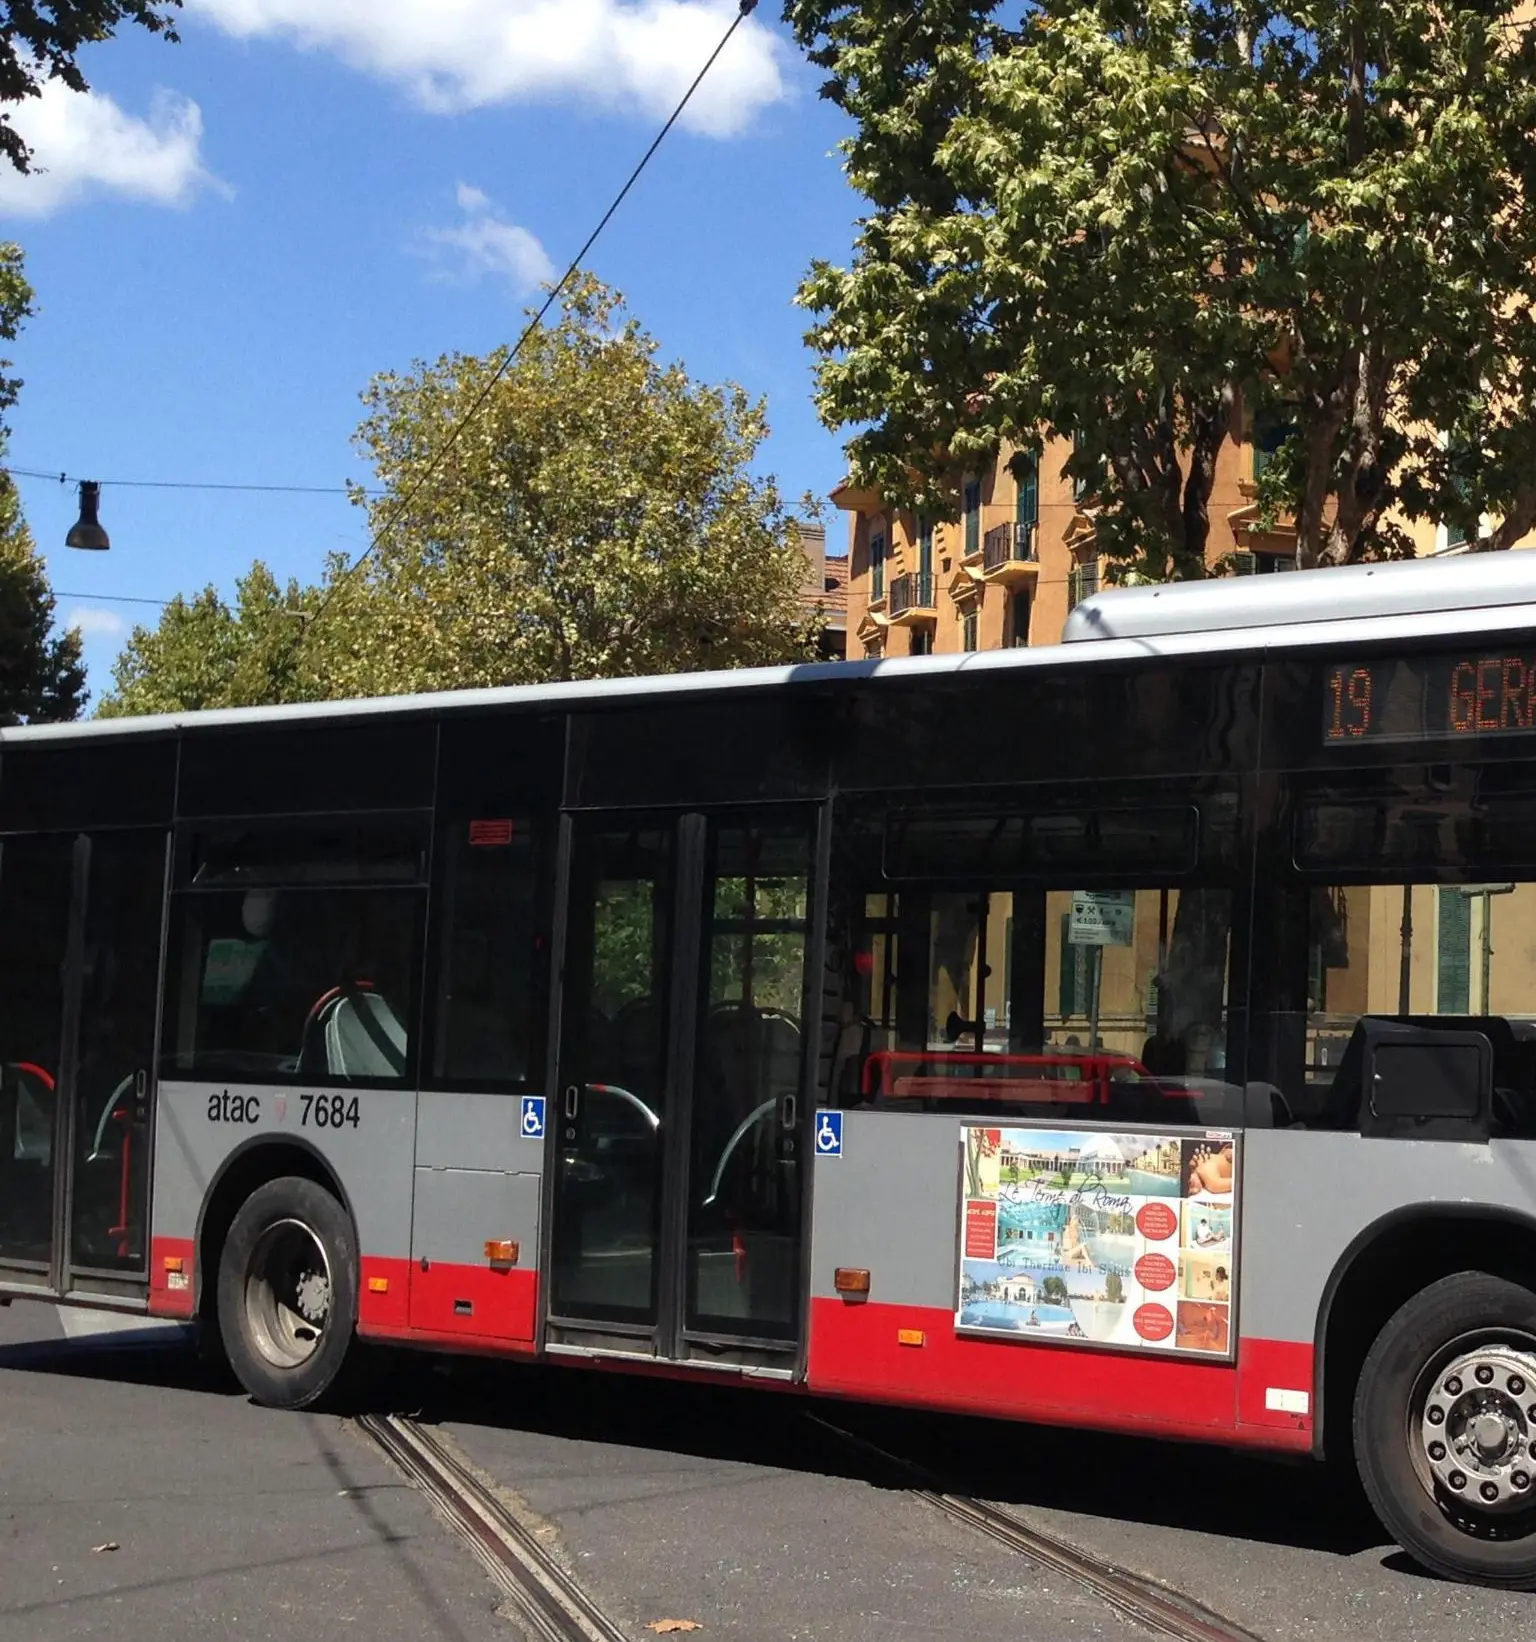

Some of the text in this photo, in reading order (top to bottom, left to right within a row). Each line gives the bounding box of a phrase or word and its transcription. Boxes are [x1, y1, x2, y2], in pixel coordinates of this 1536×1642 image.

[1326, 667, 1374, 739] 19
[207, 1089, 361, 1129] atac 7684
